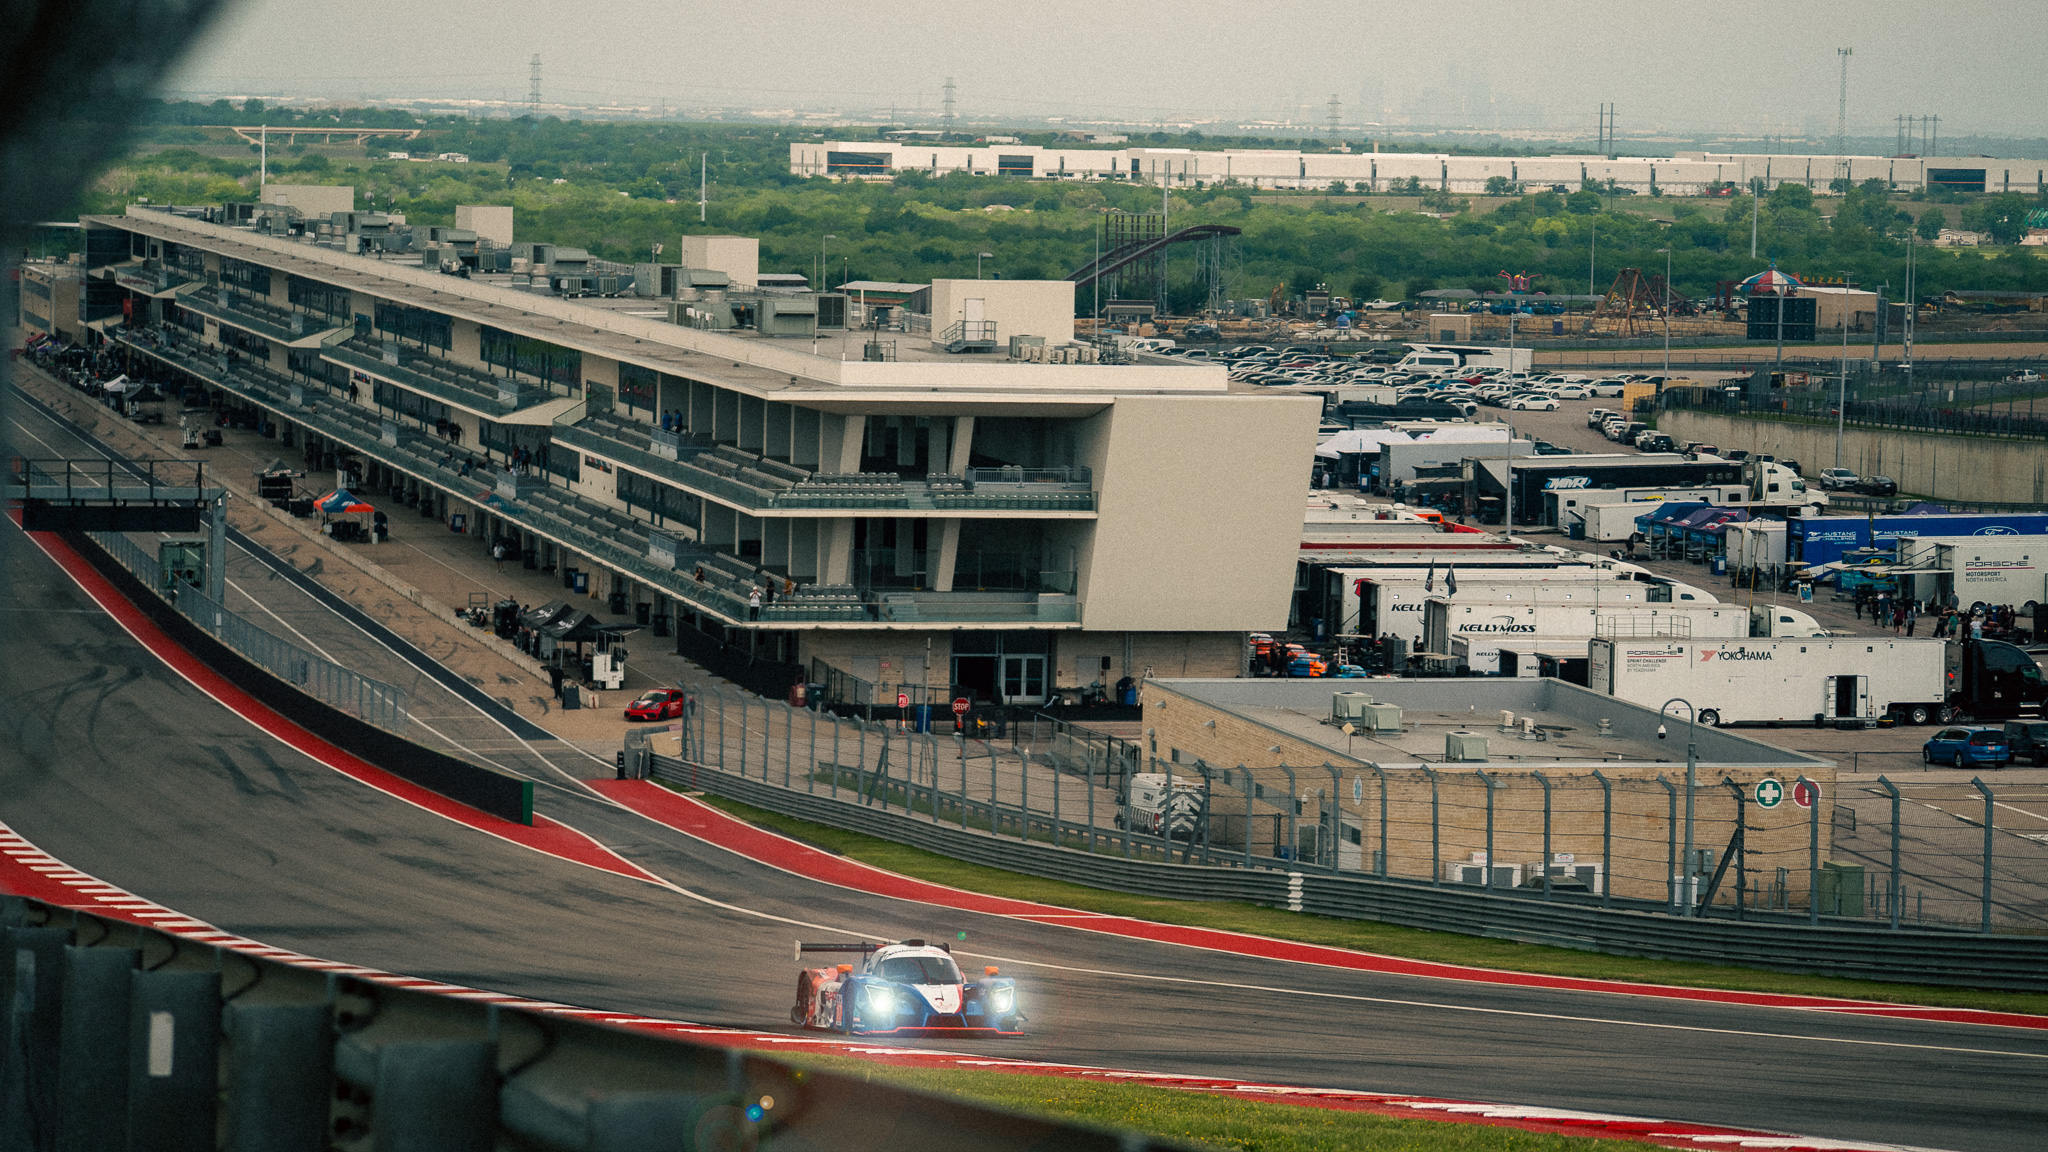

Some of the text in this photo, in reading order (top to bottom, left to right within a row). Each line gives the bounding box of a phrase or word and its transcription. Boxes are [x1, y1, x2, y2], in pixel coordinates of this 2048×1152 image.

[1803, 276, 1843, 284] PIZZA
[1459, 623, 1537, 633] KELLYMOSS
[1717, 651, 1773, 661] YOKOHAMA
